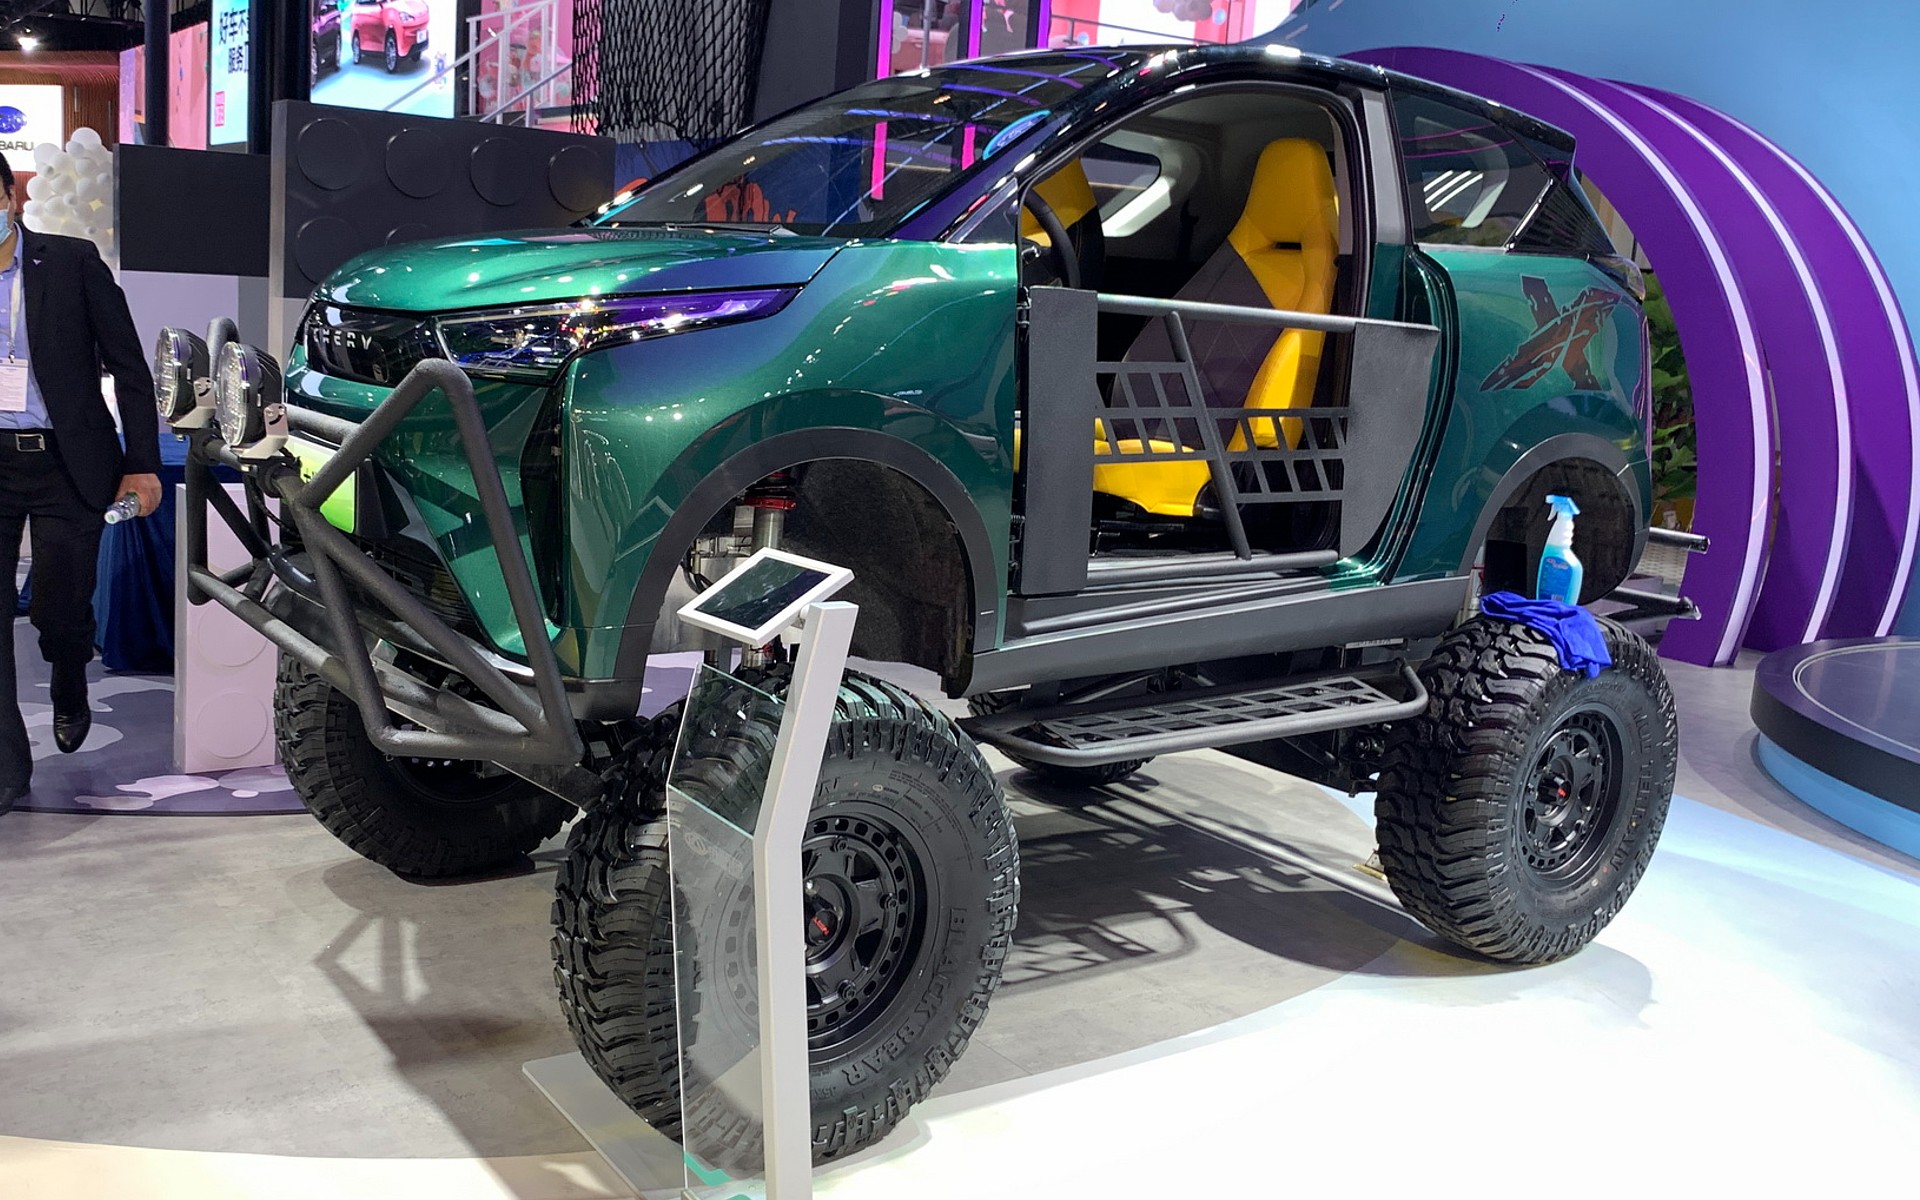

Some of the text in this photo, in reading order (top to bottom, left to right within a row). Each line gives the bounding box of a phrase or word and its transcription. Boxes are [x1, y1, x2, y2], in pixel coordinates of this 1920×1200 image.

[220, 8, 249, 44] 好车不
[313, 327, 372, 350] CHERY
[914, 907, 967, 1018] BLACK
[841, 1018, 925, 1086] BEAR
